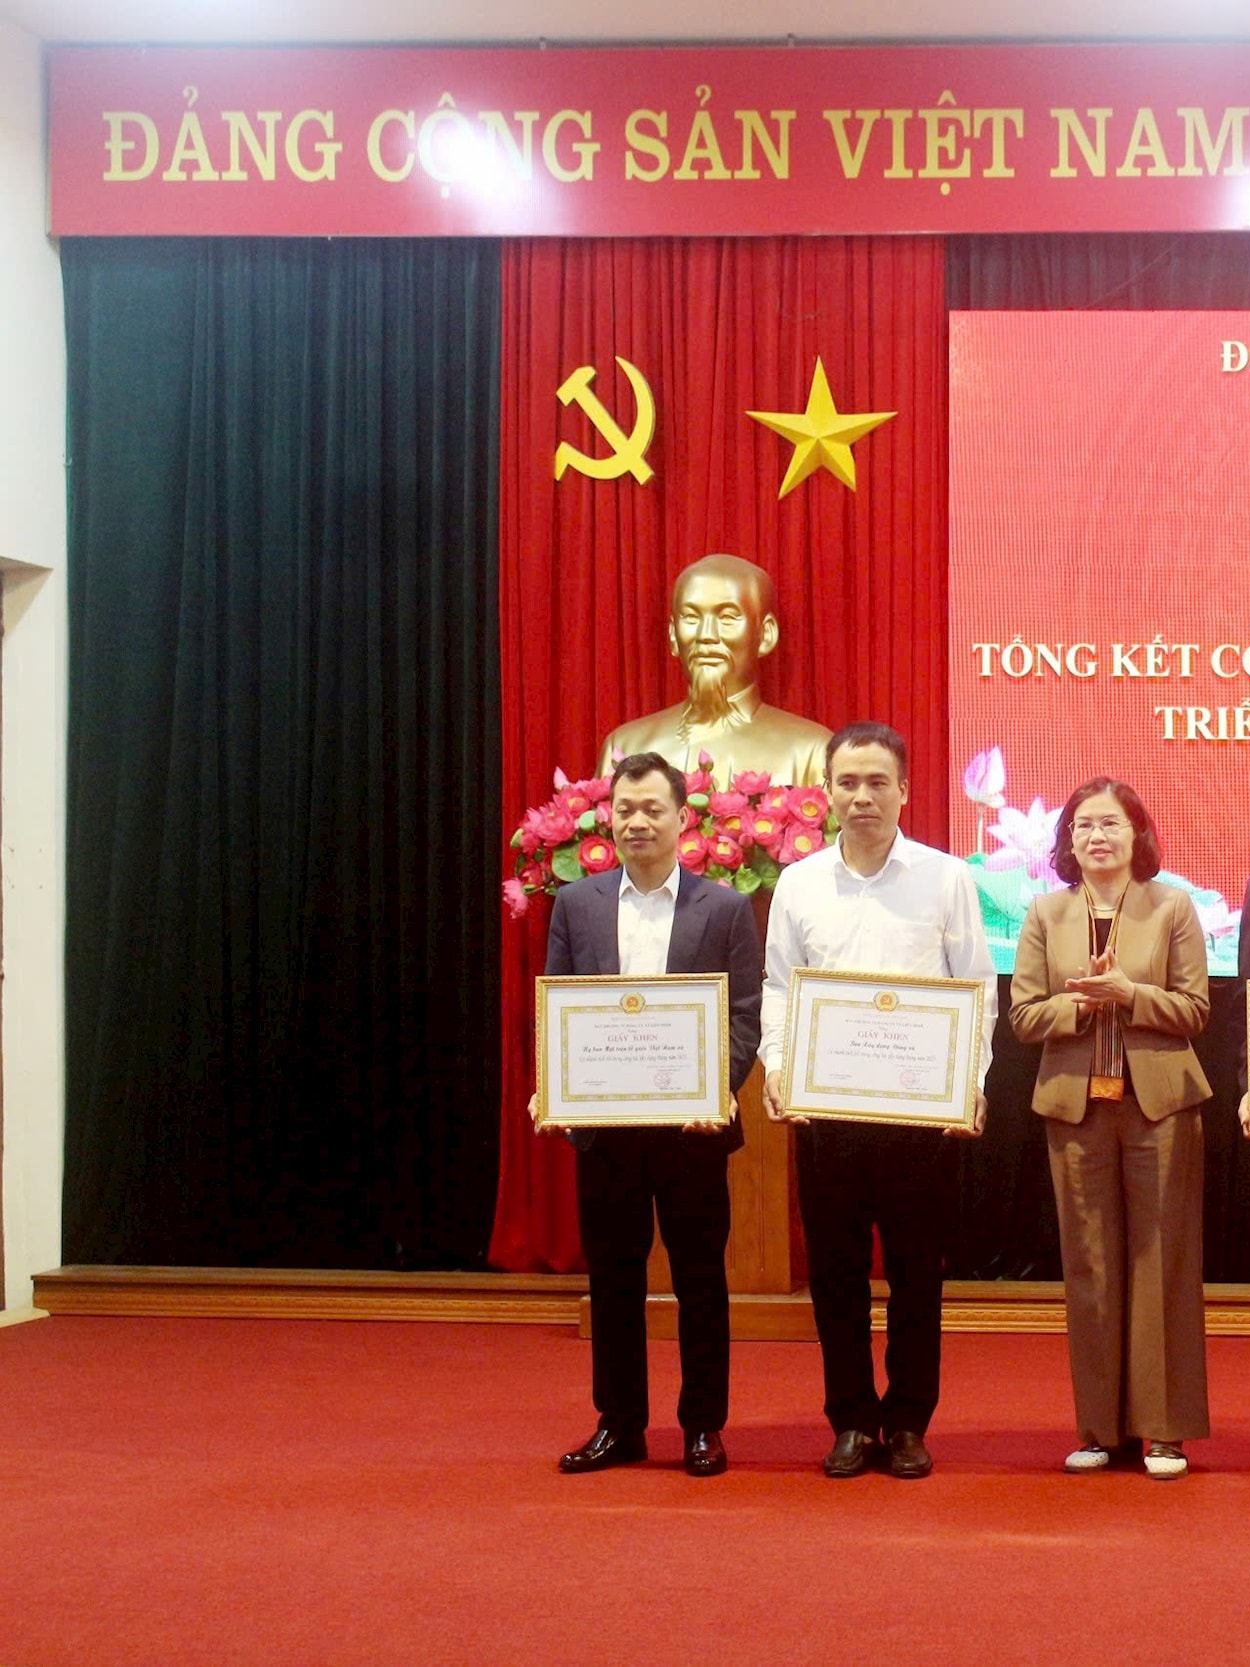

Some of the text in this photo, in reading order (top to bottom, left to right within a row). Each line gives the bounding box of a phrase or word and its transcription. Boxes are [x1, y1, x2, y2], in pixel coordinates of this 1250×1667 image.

[103, 86, 342, 183] ĐẢNG
[367, 92, 600, 198] CỘNG
[624, 85, 796, 183] SẢN
[823, 90, 1024, 195] VIỆT
[1050, 107, 1250, 178] NAM
[972, 634, 1099, 678] TỔNG
[1112, 634, 1200, 678] KẾT
